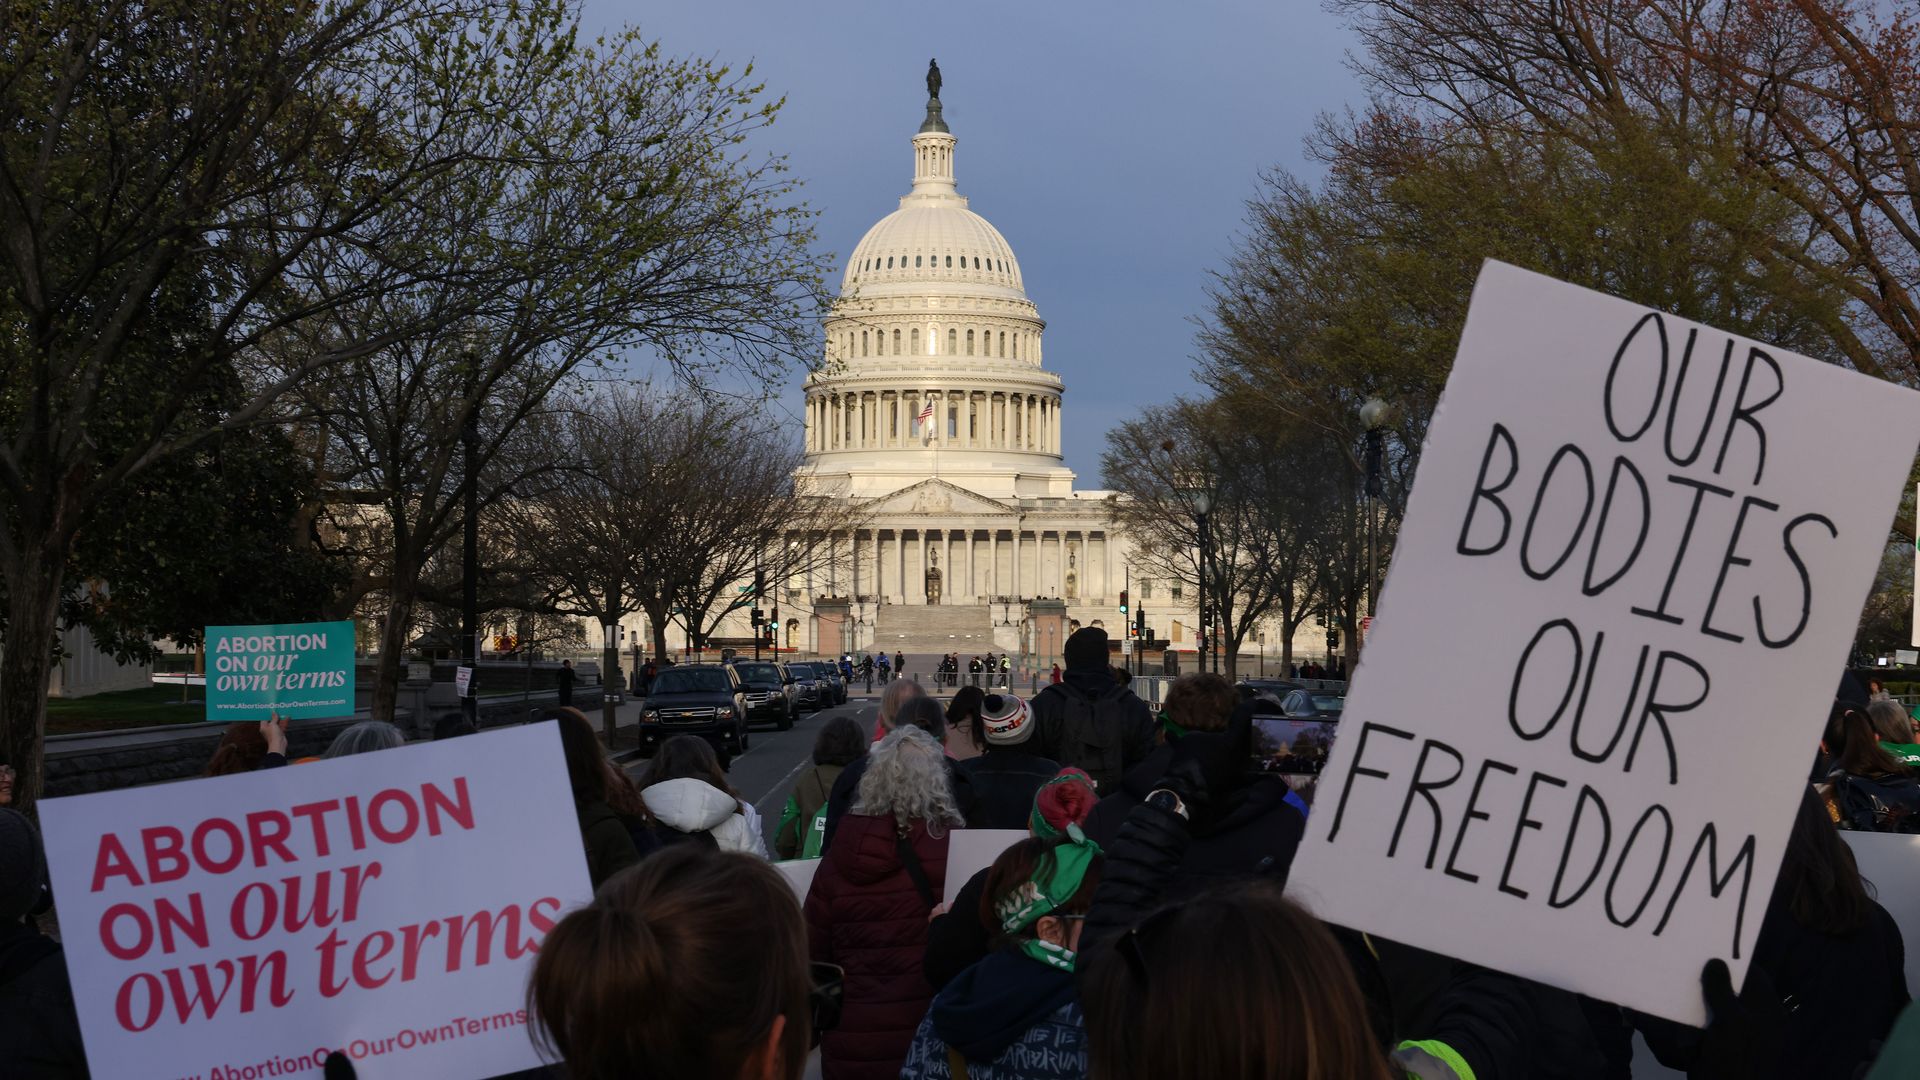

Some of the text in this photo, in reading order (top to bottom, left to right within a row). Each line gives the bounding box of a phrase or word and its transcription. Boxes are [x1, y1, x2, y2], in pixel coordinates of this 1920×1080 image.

[1604, 311, 1784, 485] OUR
[1456, 422, 1838, 650] BODIES
[215, 633, 327, 654] ABORTION
[215, 653, 299, 673] ON our
[216, 670, 346, 692] own terms
[1507, 617, 1710, 785] OUR
[216, 698, 346, 710] www.AbortionOnOurOwnTerms.com
[90, 776, 475, 893] ABORTION
[1327, 720, 1757, 960] FREEDOM
[98, 861, 383, 961] ON our
[114, 896, 562, 1034] own terms
